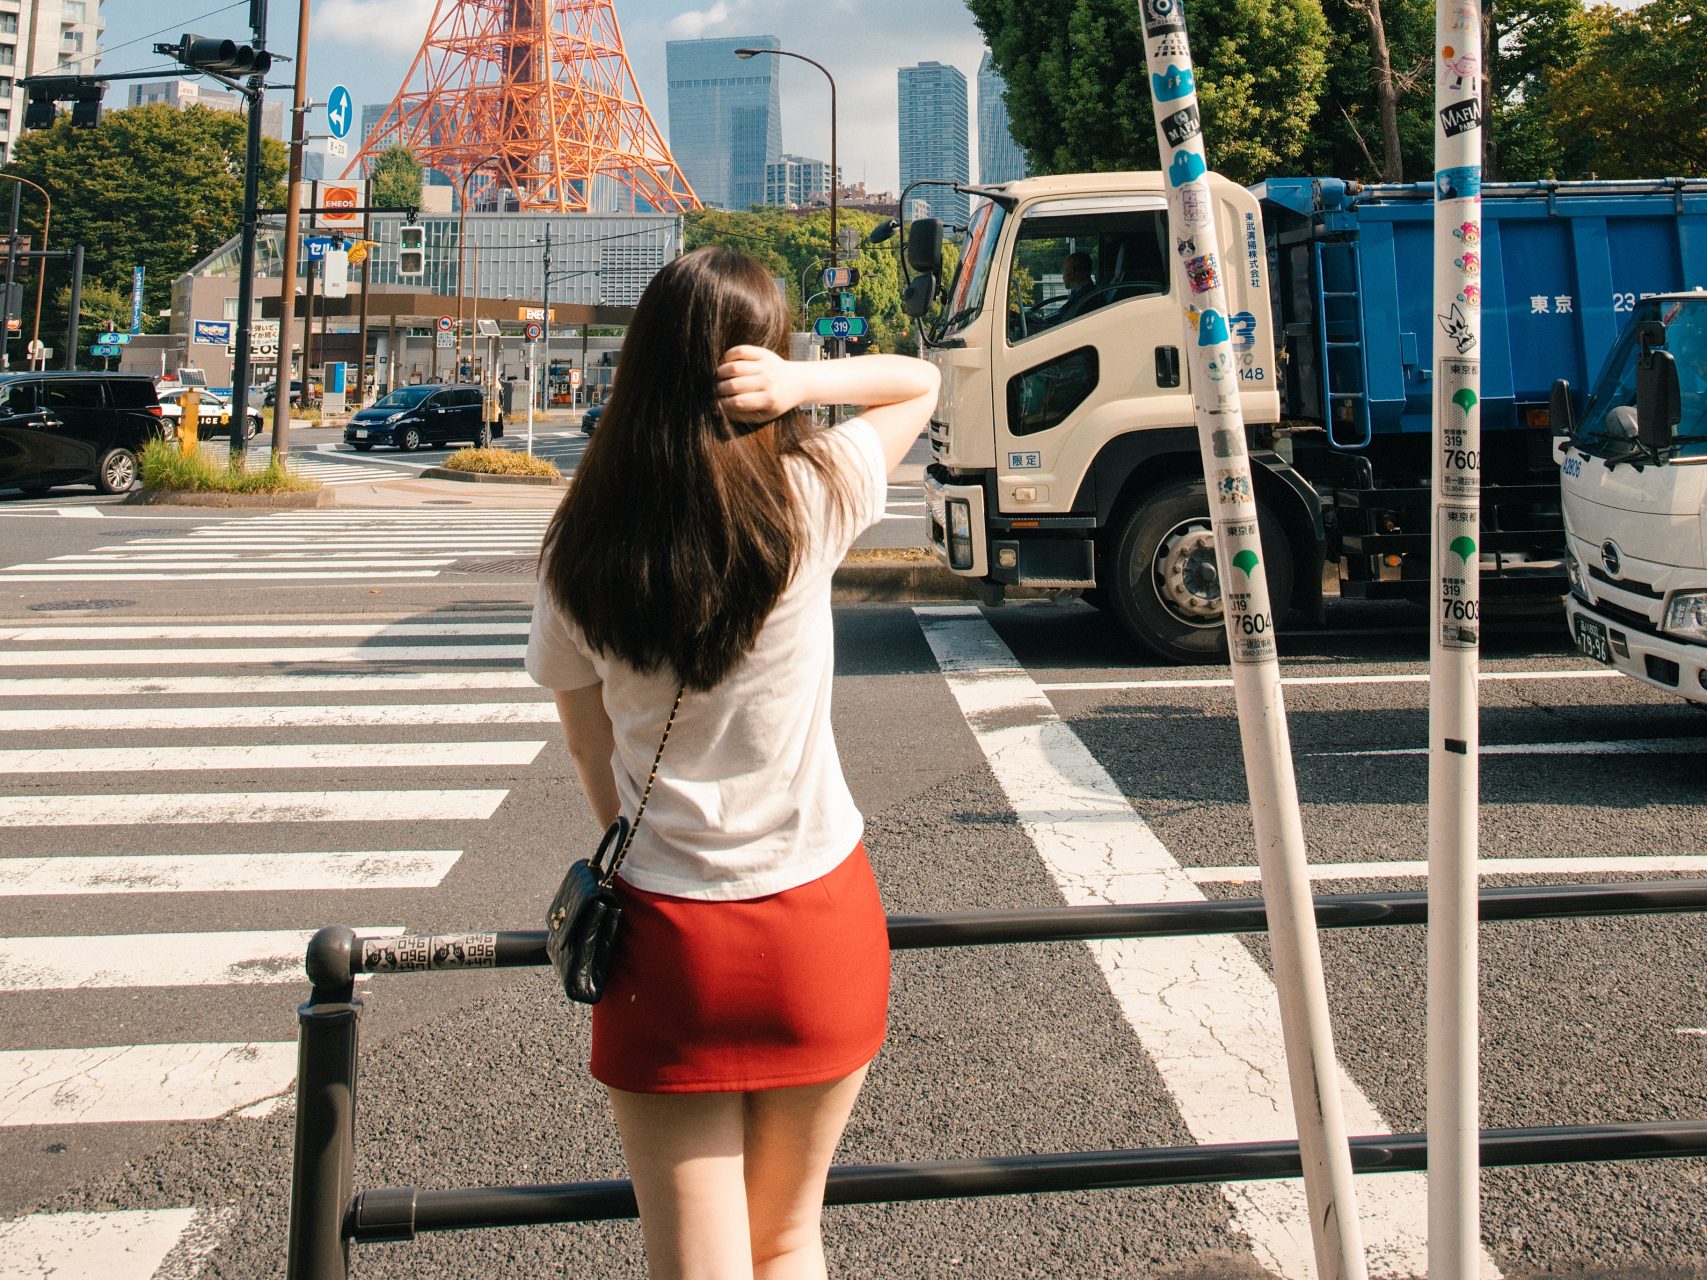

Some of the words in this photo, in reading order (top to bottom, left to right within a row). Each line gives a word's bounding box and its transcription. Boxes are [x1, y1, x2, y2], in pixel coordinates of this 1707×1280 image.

[1442, 101, 1481, 130] MAFIA
[1459, 120, 1477, 132] PARIS
[325, 200, 354, 208] ENEOS
[1530, 294, 1573, 314] 東京
[529, 327, 538, 335] 40
[833, 321, 848, 333] 319
[1444, 436, 1462, 447] 319
[1012, 455, 1037, 467] 限定
[1443, 585, 1460, 596] 319
[1231, 600, 1247, 612] 319
[1443, 599, 1479, 620] 7603
[1231, 612, 1272, 635] 7604
[400, 949, 427, 962] 096
[468, 944, 494, 957] 096
